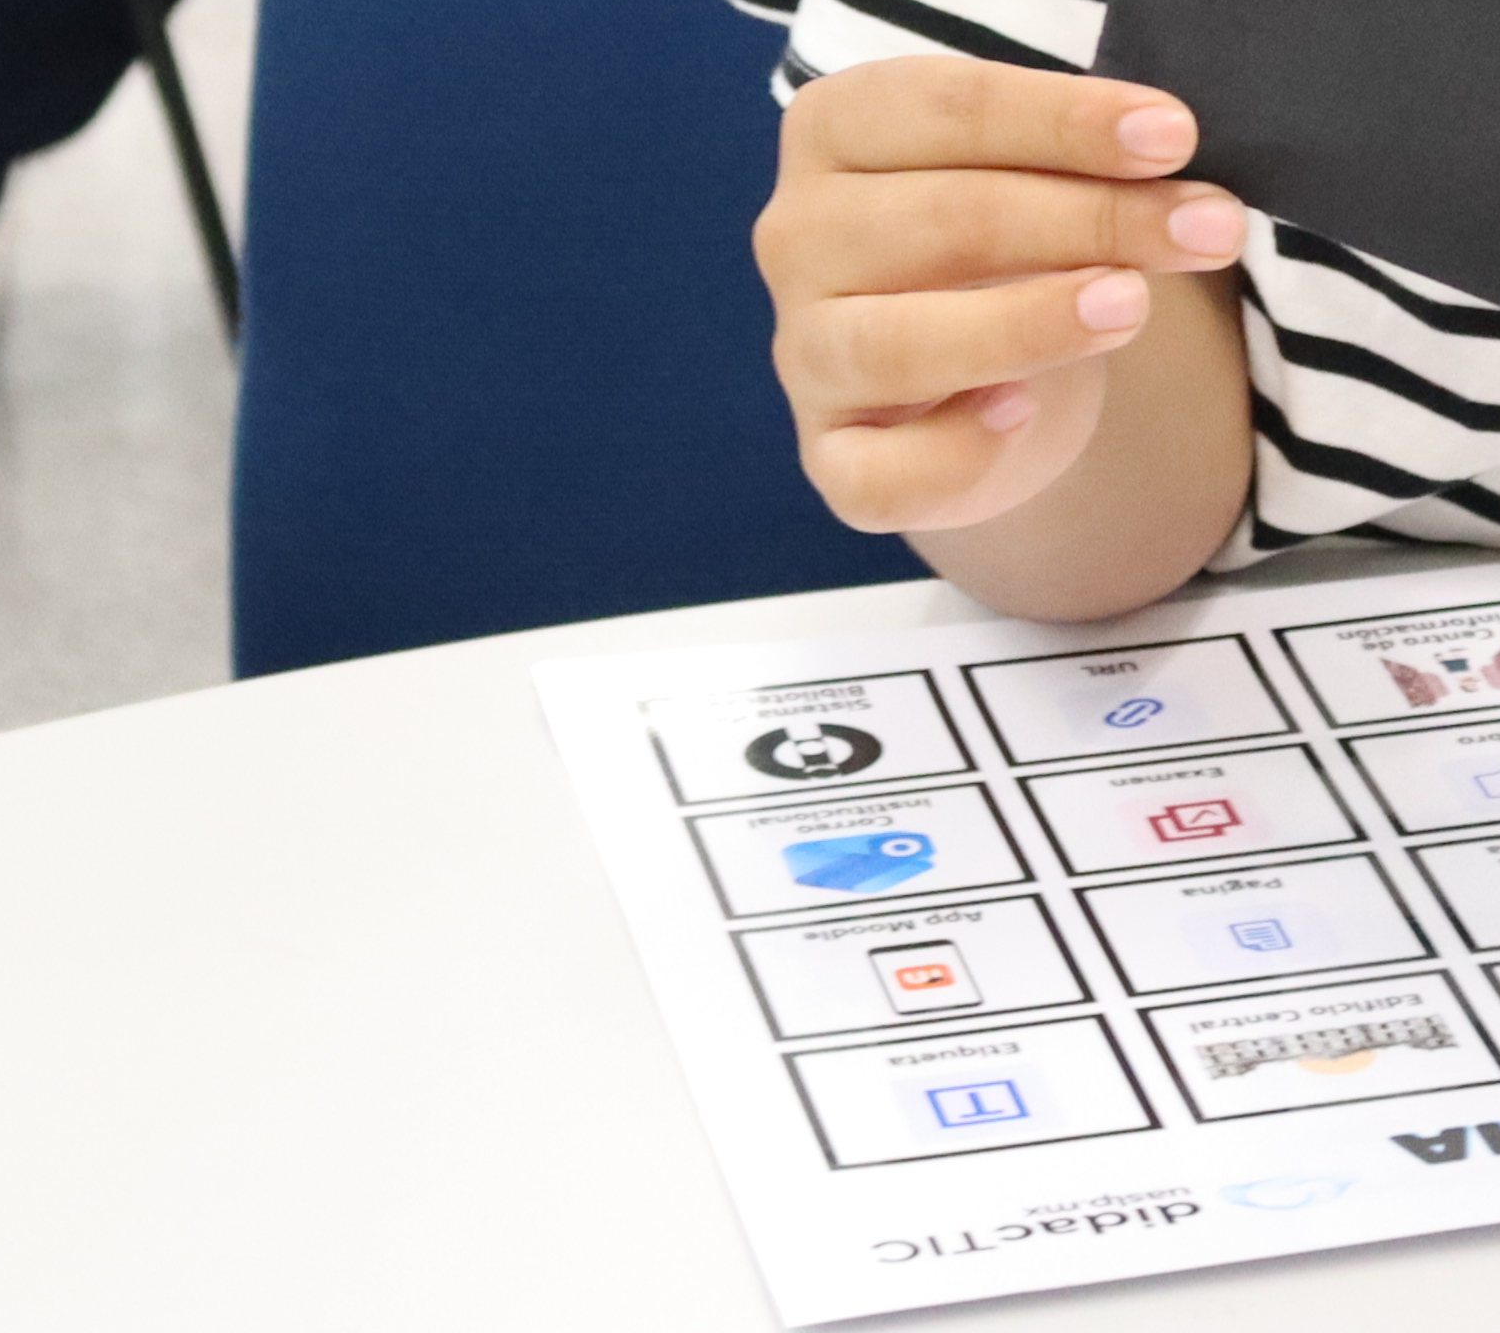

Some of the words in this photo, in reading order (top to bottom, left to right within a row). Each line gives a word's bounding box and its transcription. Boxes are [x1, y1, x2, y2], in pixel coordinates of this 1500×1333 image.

[1361, 639, 1395, 654] de
[1402, 627, 1493, 646] Centro
[1081, 662, 1139, 677] URL
[756, 698, 872, 719] Sistema
[1109, 766, 1224, 788] Examen
[796, 815, 893, 834] Correo
[924, 909, 983, 925] App
[802, 919, 916, 942] Moodle
[1310, 993, 1423, 1015] Edificio
[1189, 1010, 1300, 1033] Central
[888, 1041, 1020, 1067] Etiqueta
